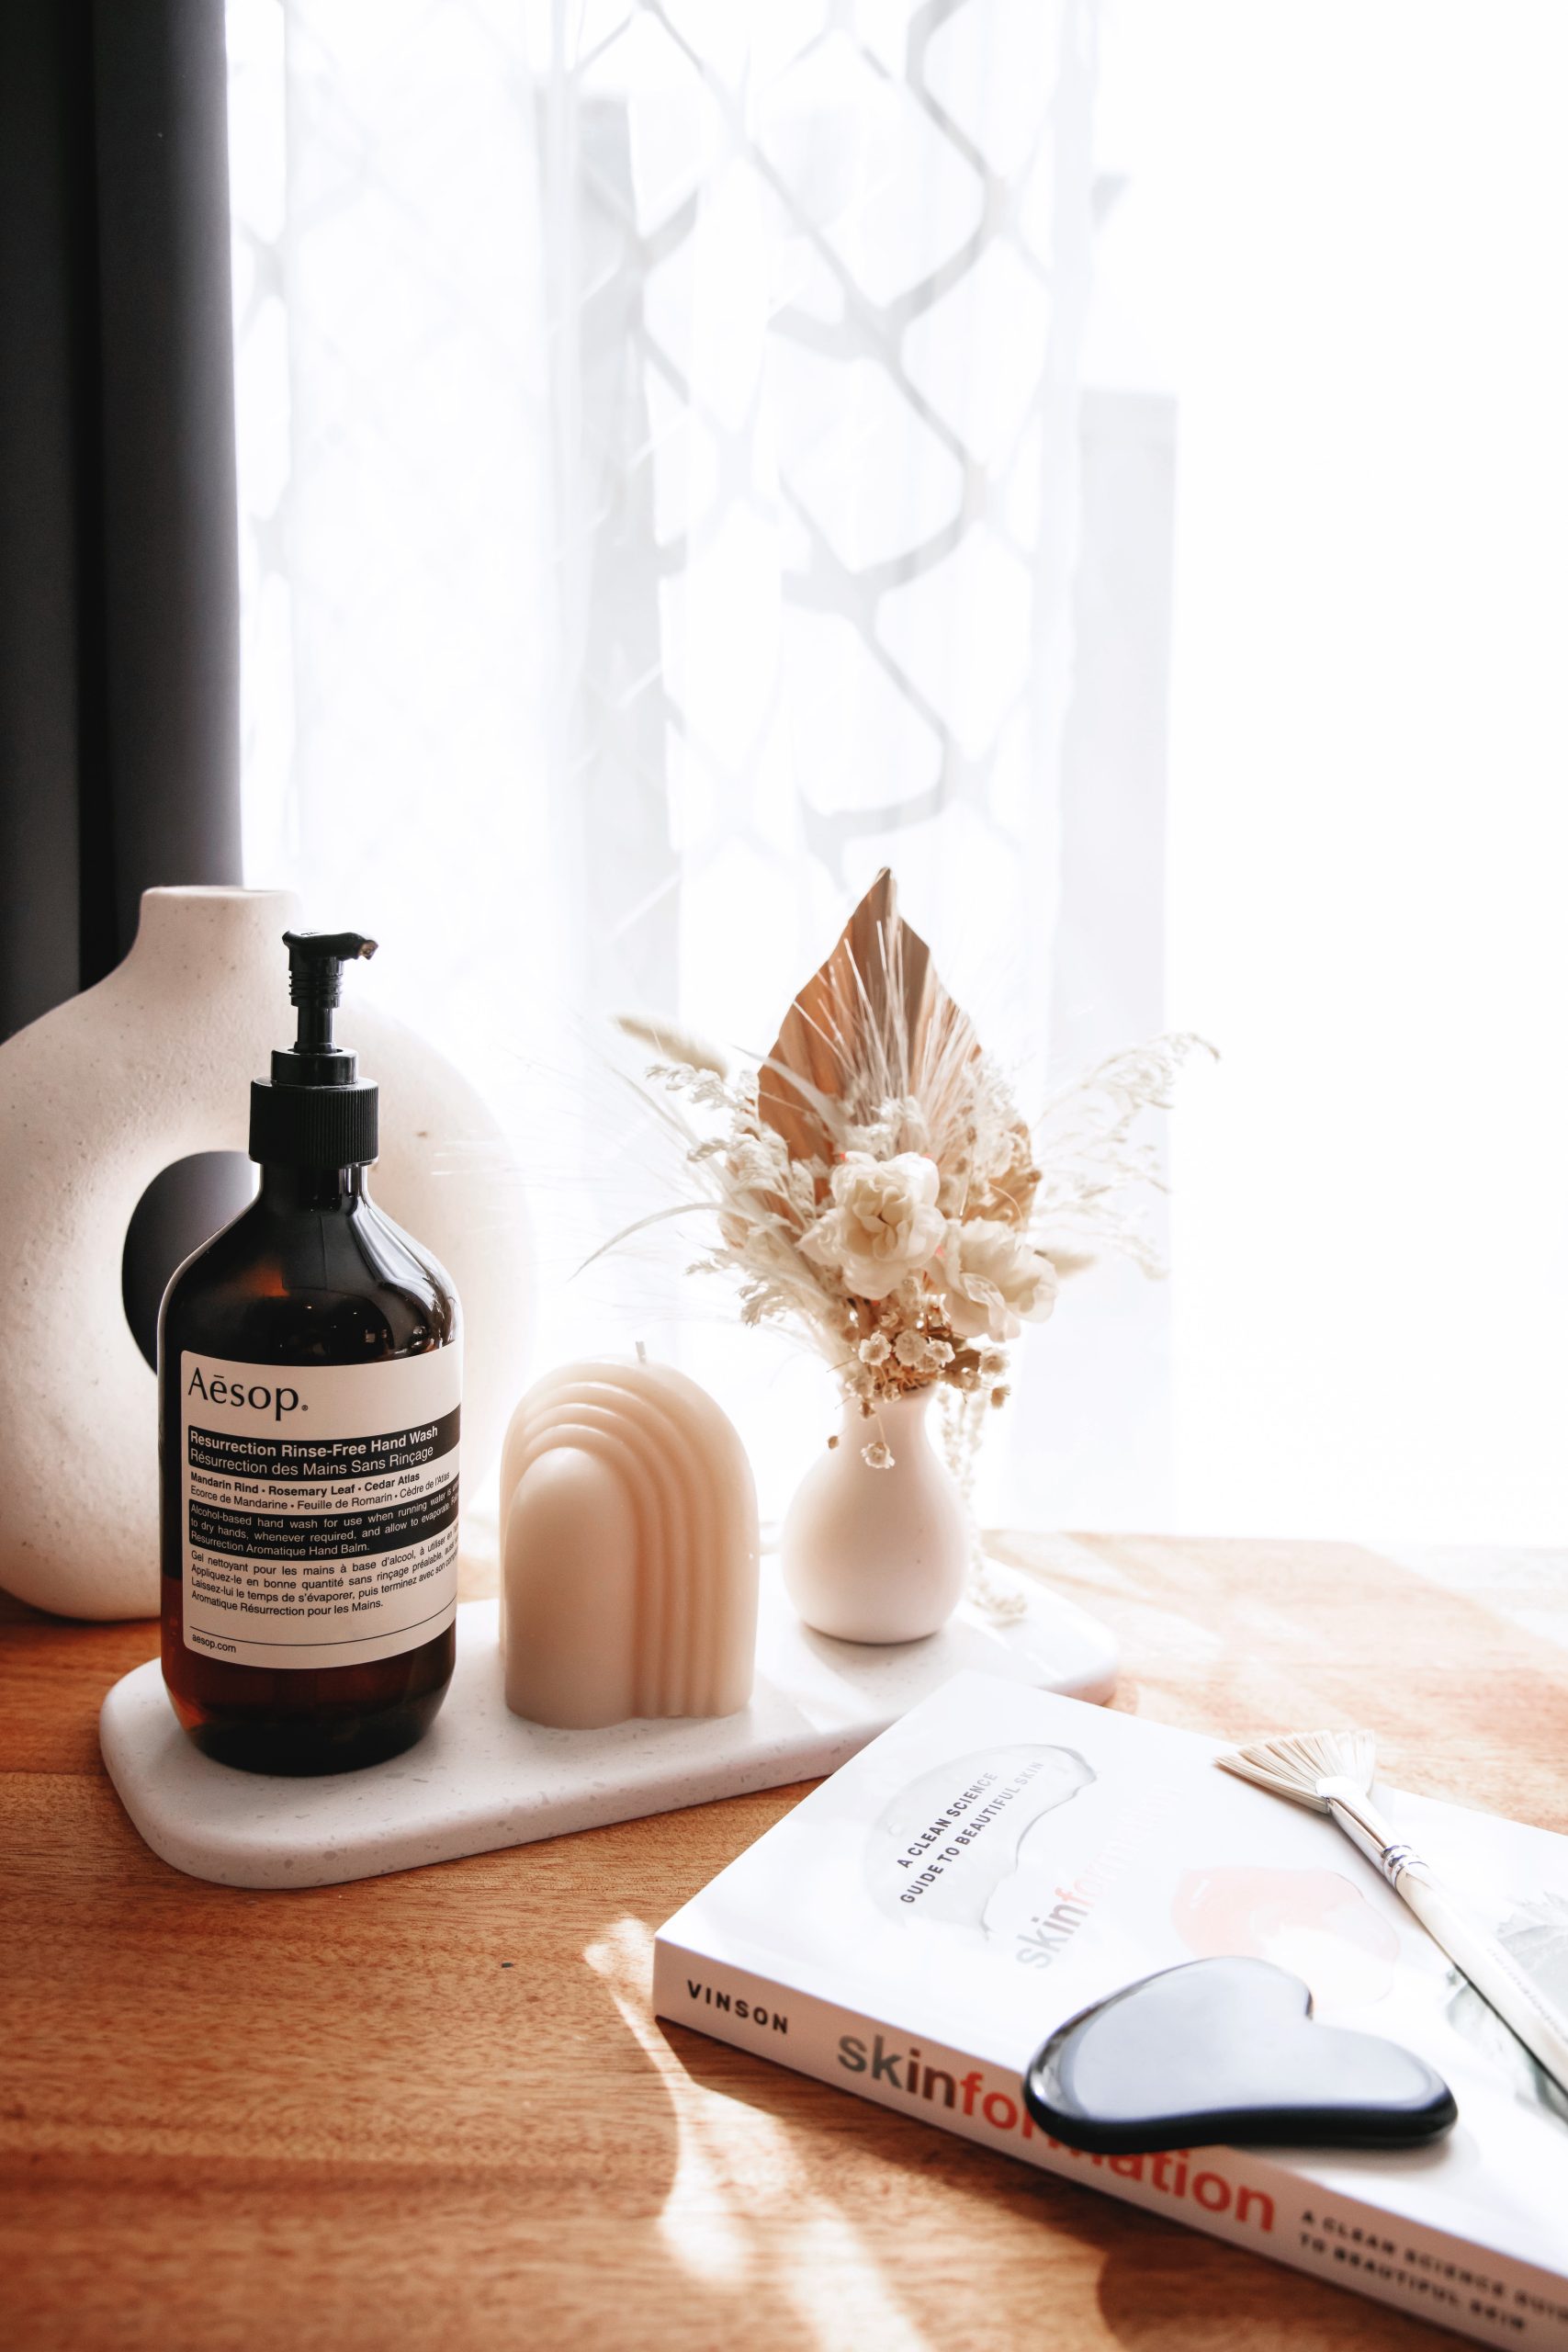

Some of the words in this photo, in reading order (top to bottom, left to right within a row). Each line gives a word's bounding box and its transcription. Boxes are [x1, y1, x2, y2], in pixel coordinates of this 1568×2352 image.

[190, 1430, 276, 1456] Resurrection
[281, 1444, 367, 1458] Rinse-Free
[371, 1434, 406, 1453] Hand
[410, 1425, 438, 1445] Wash
[190, 1448, 267, 1474] Résurrection
[272, 1463, 299, 1476] des
[303, 1463, 347, 1476] Mains
[351, 1459, 386, 1473] Sans
[389, 1446, 434, 1467] Rinçage
[190, 1471, 231, 1489] Mandarin
[234, 1481, 259, 1494] Rind
[268, 1486, 328, 1498] Rosemary
[331, 1484, 355, 1495] Leaf
[364, 1479, 395, 1492] Cedar
[397, 1473, 420, 1487] Atlas
[190, 1485, 218, 1500] Ecorce
[220, 1493, 231, 1503] de
[233, 1495, 288, 1510] Mandarine
[297, 1499, 332, 1510] Feuille
[335, 1498, 348, 1509] de
[351, 1492, 392, 1507] Romarin
[400, 1484, 424, 1498] Cèdre
[425, 1480, 434, 1490] de
[190, 1503, 252, 1526] Alcohol-based
[257, 1517, 284, 1528] hand
[289, 1519, 318, 1529] wash
[323, 1519, 338, 1528] for
[344, 1517, 363, 1526] use
[367, 1511, 394, 1523] when
[398, 1501, 427, 1518] running
[430, 1492, 446, 1507] water
[190, 1518, 198, 1527] to
[201, 1521, 214, 1534] dry
[218, 1526, 250, 1541] hands,
[254, 1532, 305, 1543] whenever
[310, 1531, 357, 1544] required,
[362, 1526, 380, 1538] and
[384, 1521, 408, 1534] allow
[411, 1517, 419, 1527] to
[190, 1530, 243, 1552] Resurrection
[245, 1544, 306, 1557] Aromatique
[309, 1544, 338, 1555] Hand
[341, 1544, 370, 1554] Balm.
[191, 1550, 204, 1562] Gel
[208, 1556, 249, 1572] nettoyant
[254, 1566, 276, 1576] pour
[282, 1566, 298, 1576] les
[303, 1565, 335, 1576] mains
[340, 1564, 347, 1574] à
[352, 1561, 377, 1573] base
[420, 1547, 425, 1556] à
[191, 1563, 243, 1585] Appliquez-le
[246, 1577, 259, 1587] en
[264, 1578, 297, 1589] bonne
[301, 1578, 344, 1590] quantité
[348, 1575, 373, 1586] sans
[377, 1566, 410, 1581] rinçage
[191, 1577, 233, 1596] Laissez-lui
[236, 1588, 245, 1598] le
[247, 1590, 278, 1603] temps
[281, 1593, 295, 1602] de
[358, 1587, 378, 1600] puis
[381, 1577, 417, 1593] terminez
[419, 1571, 434, 1582] avec
[434, 1563, 446, 1574] son
[191, 1589, 238, 1611] Aromatique
[240, 1602, 305, 1616] Résurrection
[308, 1606, 332, 1617] pour
[333, 1604, 349, 1614] les
[352, 1600, 384, 1612] Mains.
[192, 1634, 236, 1653] aesop.com
[897, 1859, 914, 1869] A
[907, 1818, 952, 1856] CLEAN
[946, 1772, 998, 1817] SCIENCE
[899, 1864, 944, 1904] GUIDE
[937, 1847, 960, 1862] TO
[954, 1788, 1021, 1845] BEAUTIFUL
[1014, 1761, 1044, 1785] SKIN
[687, 1980, 788, 2034] VINSON
[837, 2033, 1276, 2234] skinfoation
